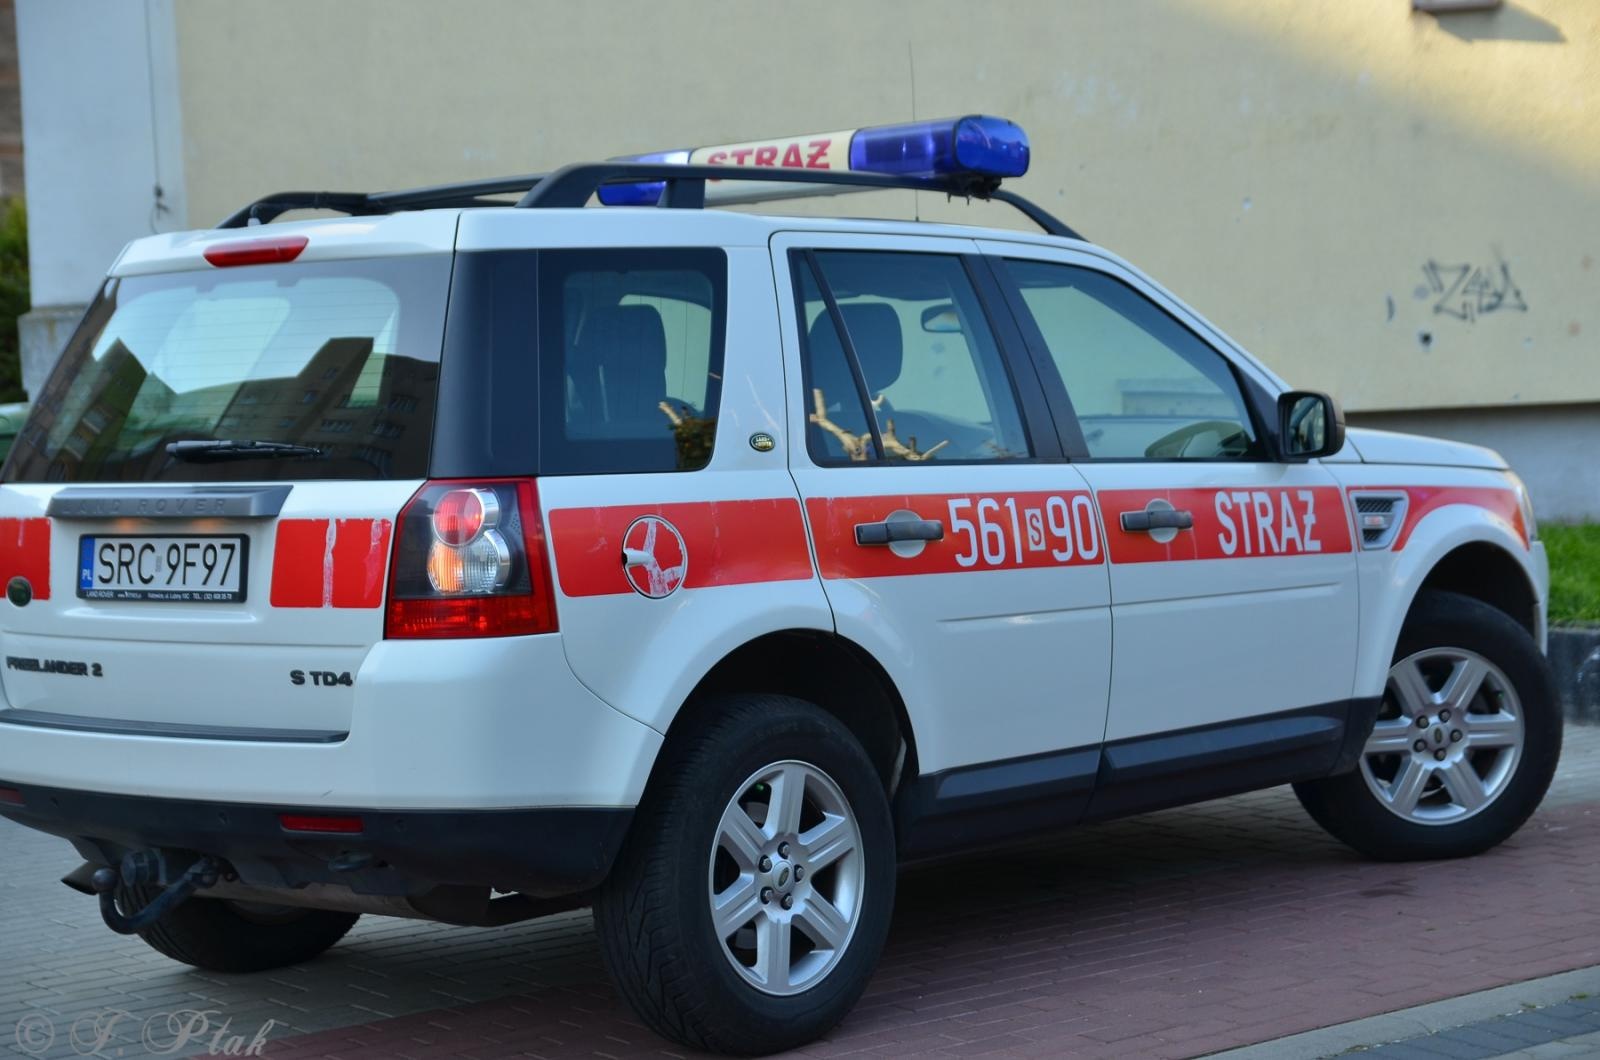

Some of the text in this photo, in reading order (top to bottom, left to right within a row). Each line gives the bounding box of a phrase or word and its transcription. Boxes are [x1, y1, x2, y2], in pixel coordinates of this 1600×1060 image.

[136, 498, 227, 515] ROVER
[98, 543, 236, 586] SRC 9F97
[82, 569, 92, 581] PL
[6, 656, 103, 678] FREELANDER 2
[290, 670, 353, 687] S TD4
